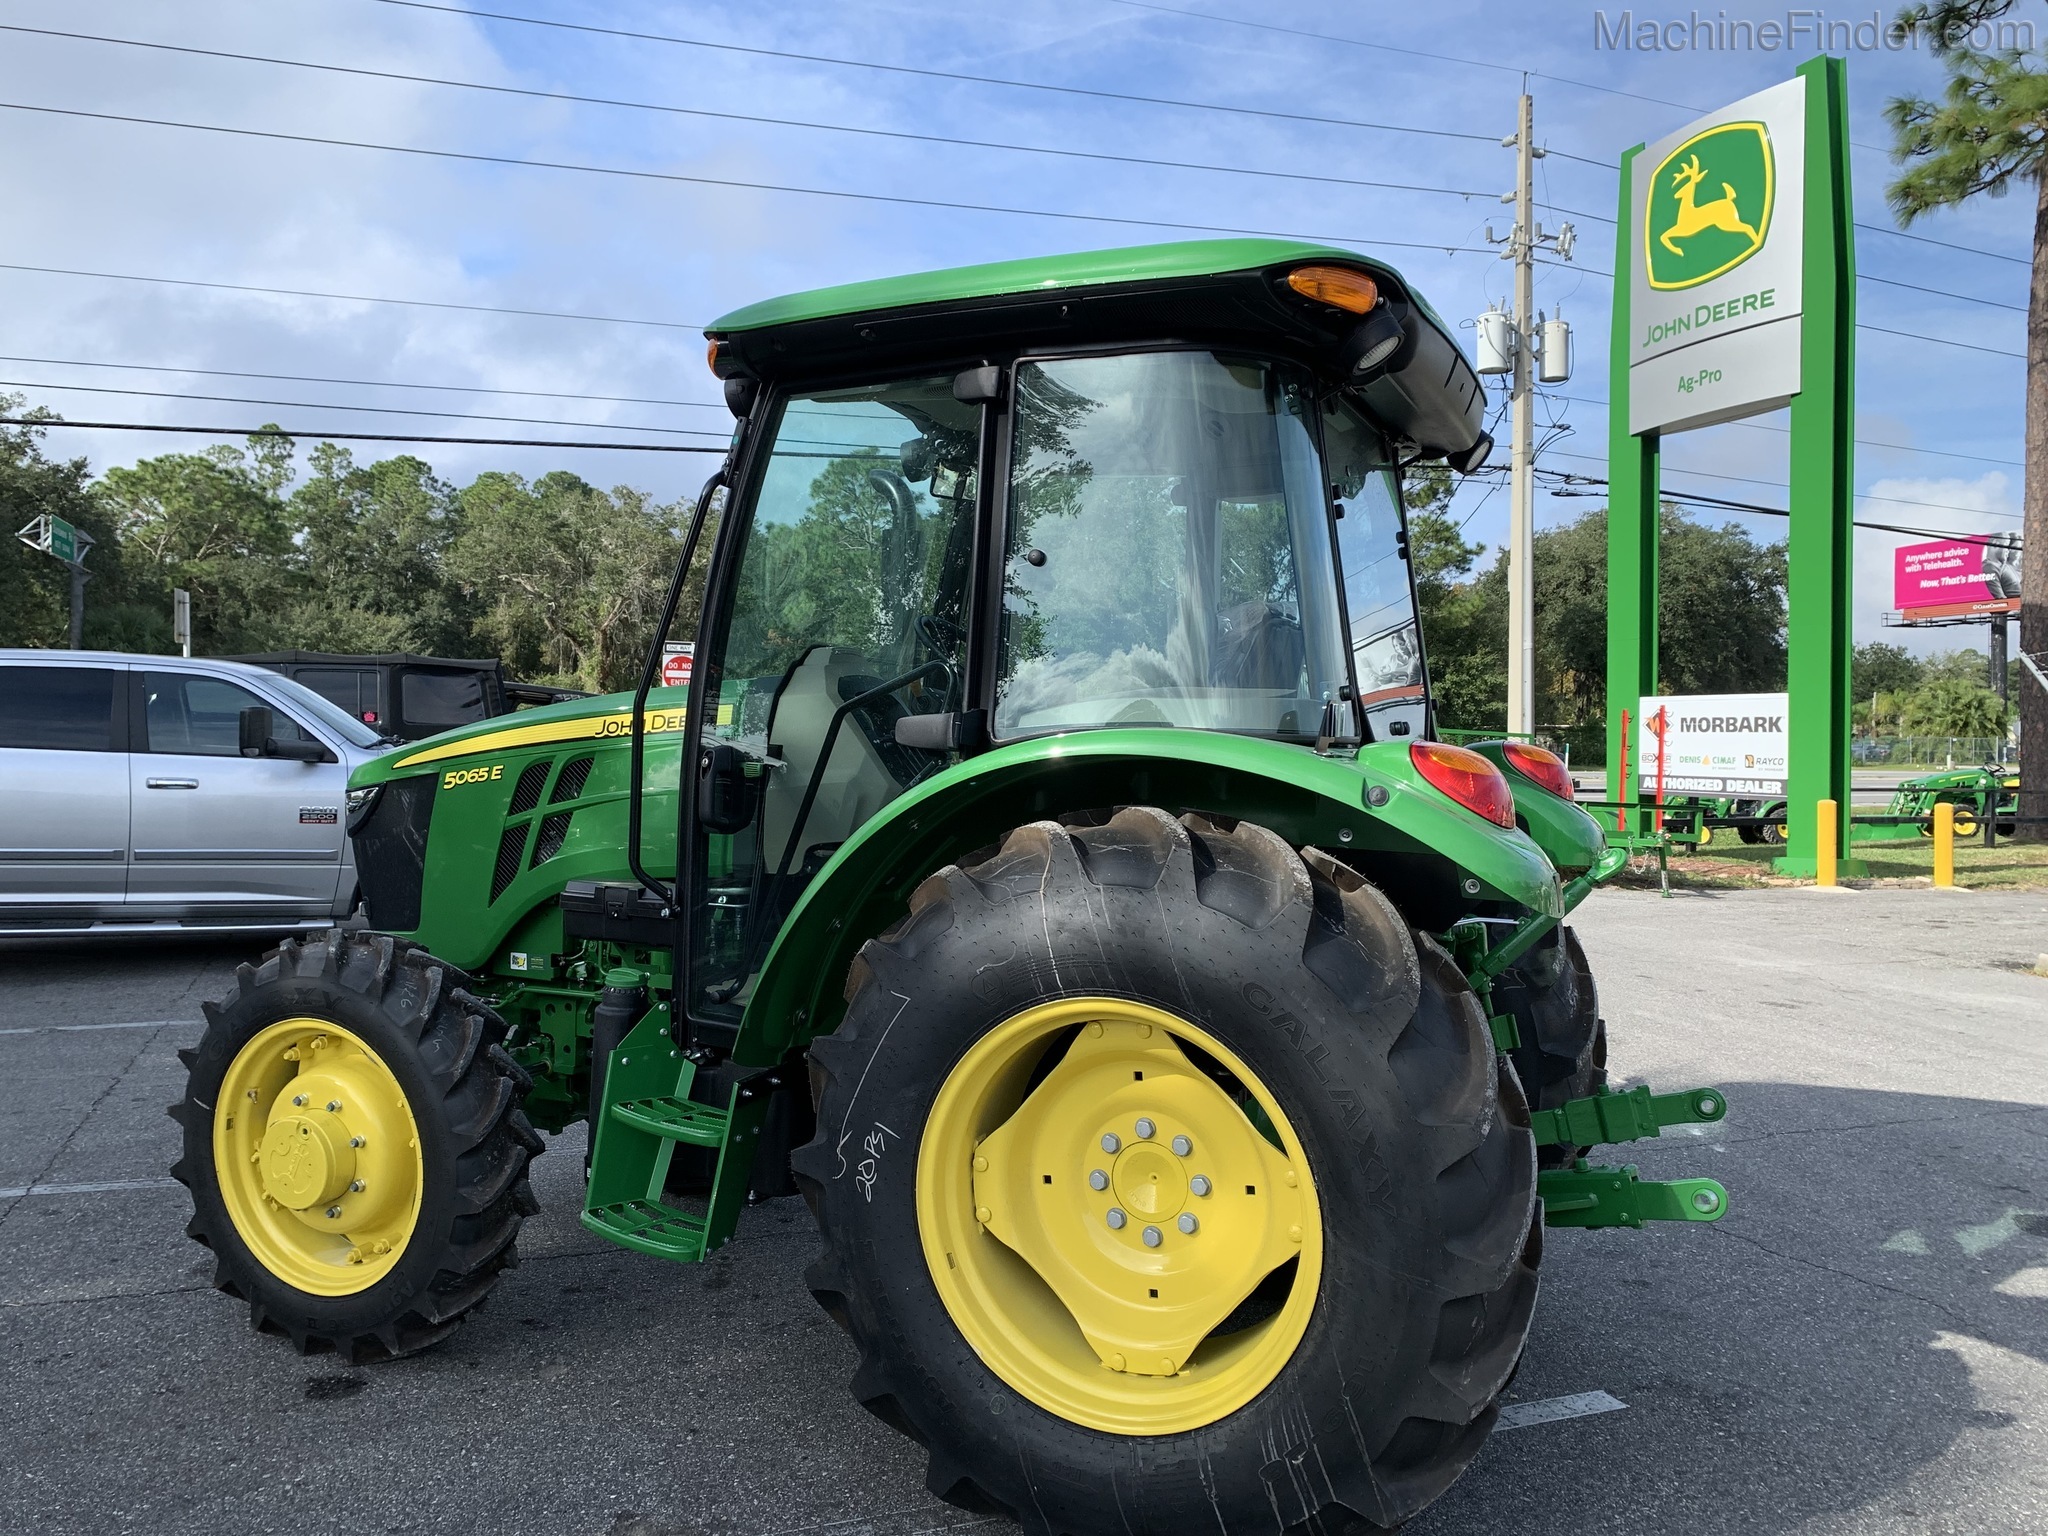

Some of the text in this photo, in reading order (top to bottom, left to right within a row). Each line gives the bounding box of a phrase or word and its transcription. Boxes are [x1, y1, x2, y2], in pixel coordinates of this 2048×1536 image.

[1643, 288, 1776, 348] JOHN DEERE
[1677, 369, 1722, 393] Ag-Pro
[1905, 547, 1970, 564] Anywhere advice
[1905, 558, 1965, 573] with Telehealth.
[1920, 573, 1996, 589] Now, That's Better.
[681, 662, 692, 670] NO
[595, 719, 646, 735] JOH
[1680, 716, 1782, 733] MORBARK
[1641, 753, 1671, 763] BOXR
[1679, 755, 1736, 764] DENIS CIMAF
[1756, 757, 1784, 765] RAYCO
[1726, 779, 1782, 794] DEALER
[1242, 982, 1397, 1217] GALAXY
